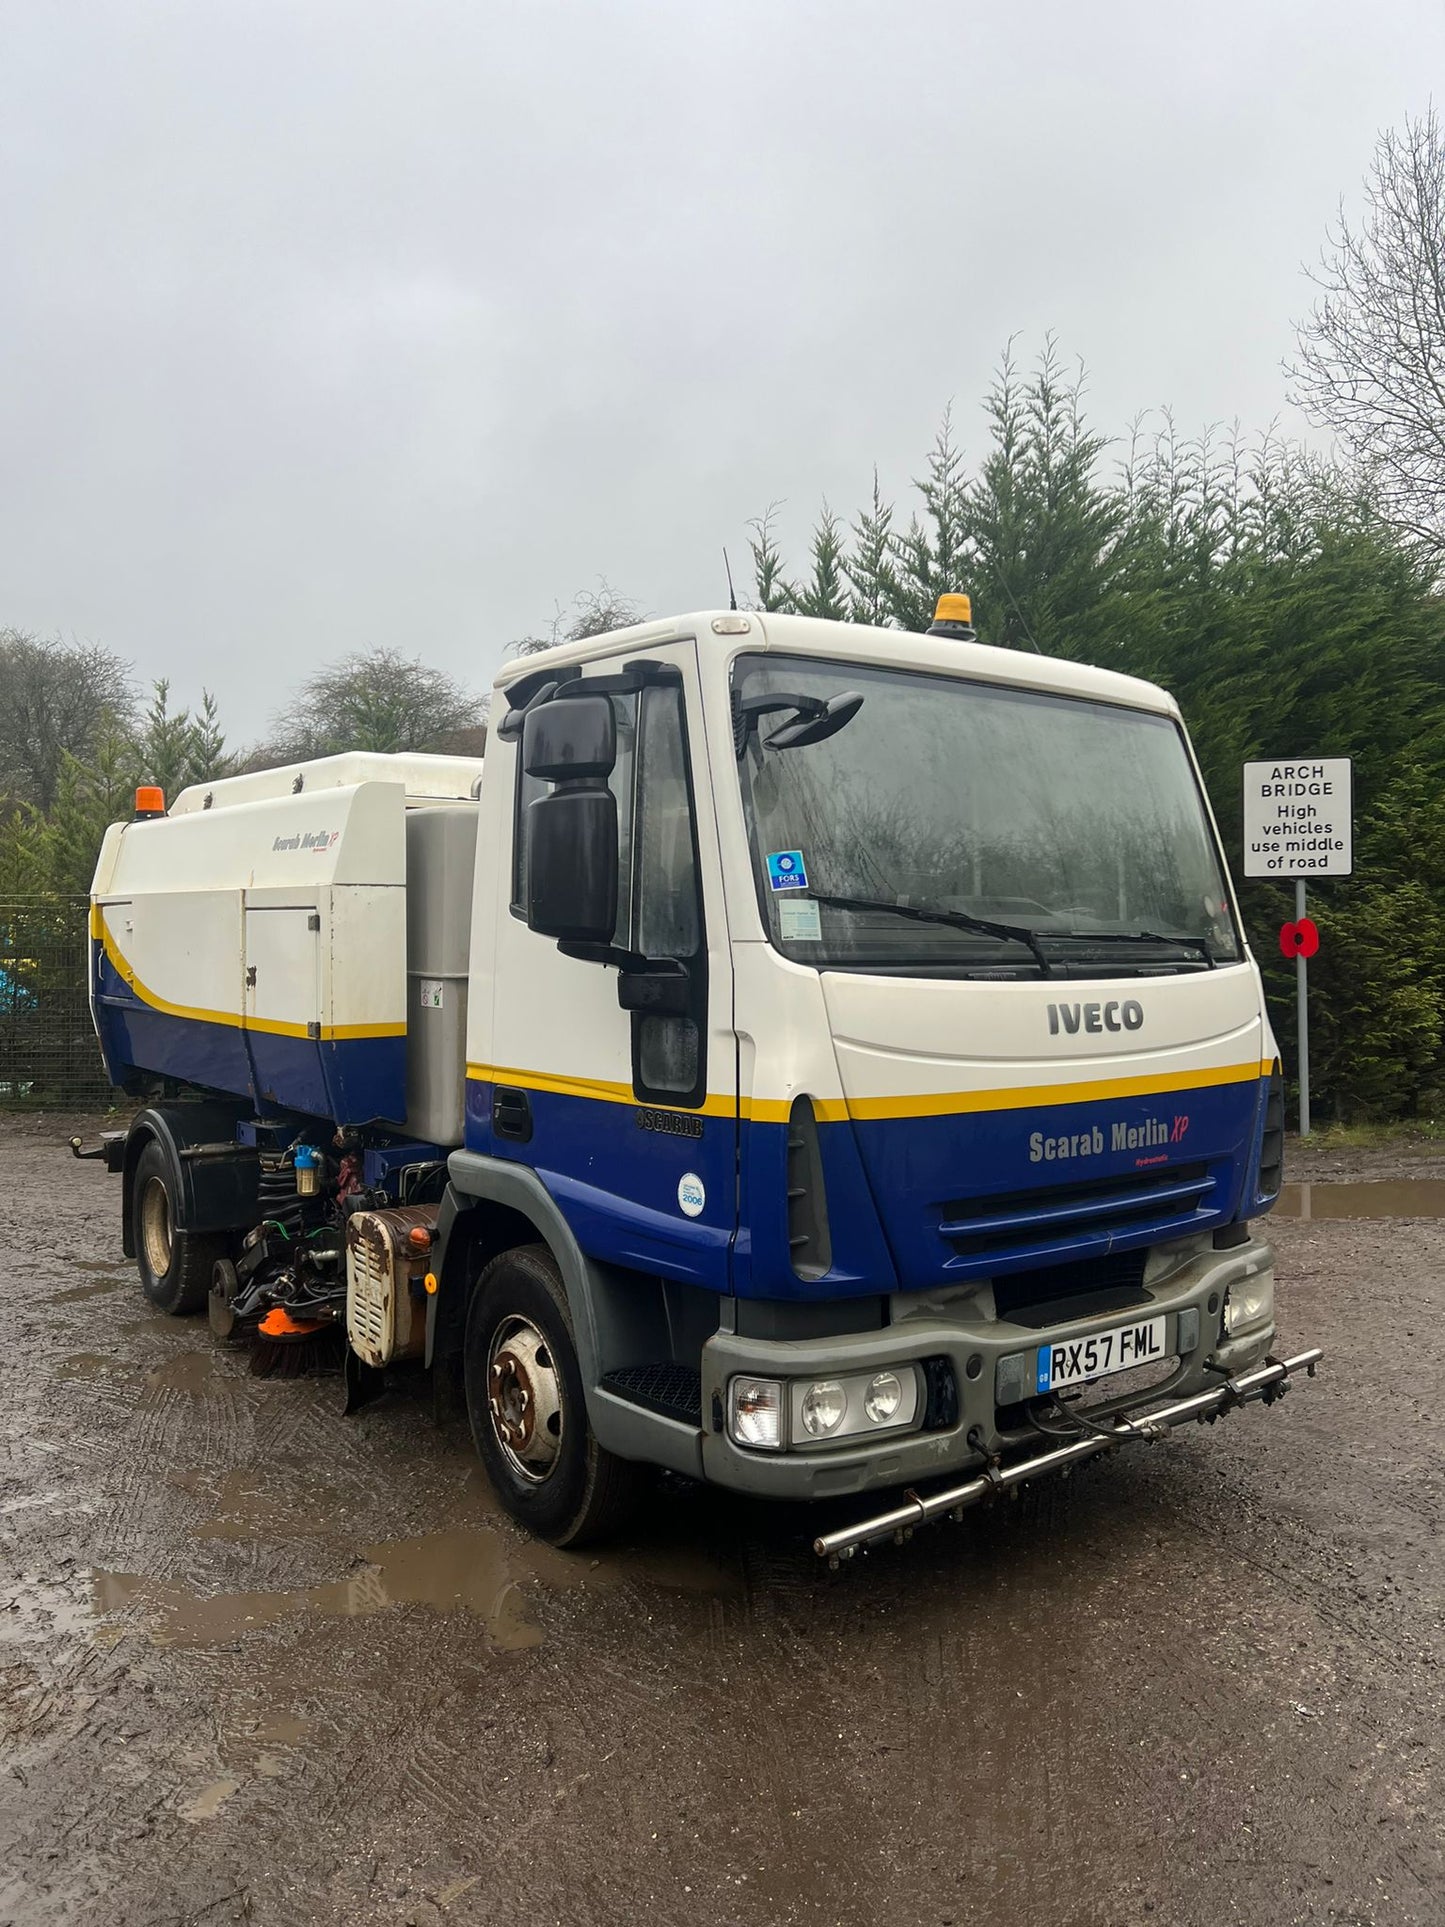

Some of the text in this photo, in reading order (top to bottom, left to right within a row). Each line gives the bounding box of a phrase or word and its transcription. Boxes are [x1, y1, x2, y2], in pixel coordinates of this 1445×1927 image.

[1271, 766, 1324, 780] ARCH
[1261, 782, 1333, 797] BRIDGE
[1277, 805, 1317, 819] High
[1262, 822, 1333, 835] vehicles
[1251, 838, 1344, 853] use middle
[1267, 855, 1328, 869] of road
[778, 874, 800, 883] FORS
[1047, 1000, 1143, 1035] IVECO
[644, 1109, 704, 1138] SCARAB
[1029, 1115, 1190, 1162] Scarab Merlin XP
[682, 1194, 703, 1206] 2006
[1051, 1324, 1160, 1382] RX57 FML
[1039, 1372, 1049, 1383] GB
